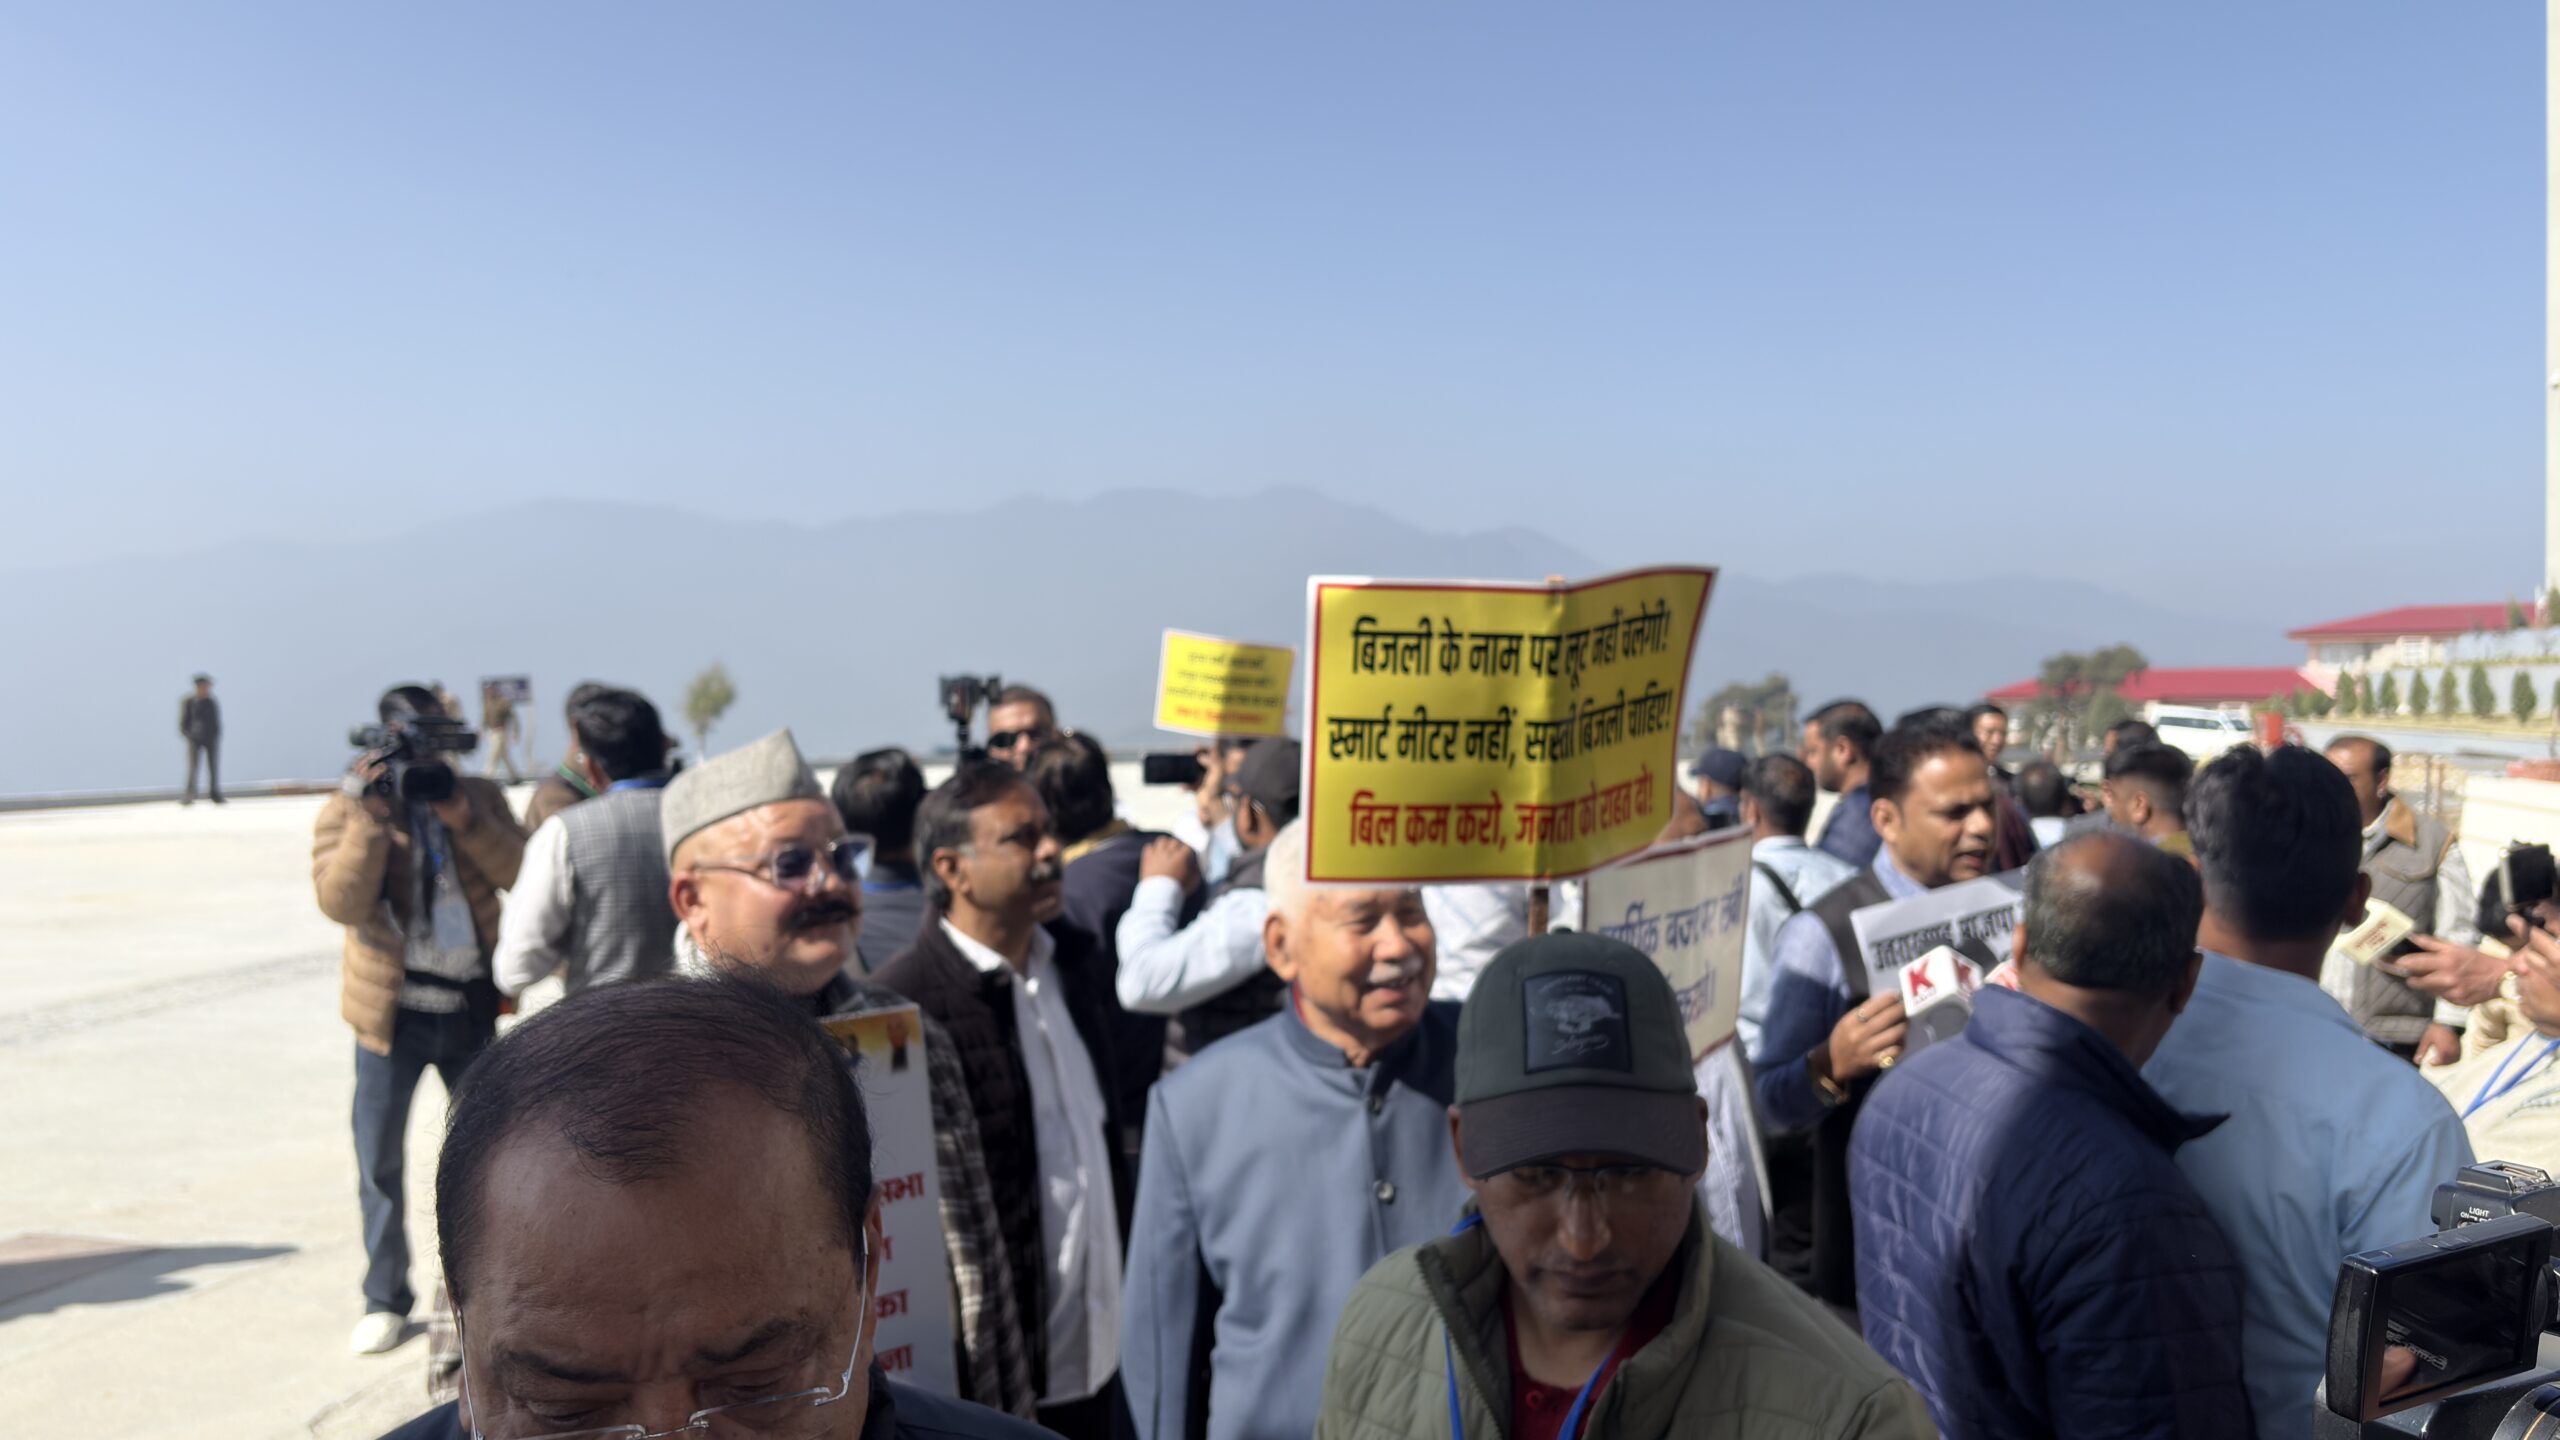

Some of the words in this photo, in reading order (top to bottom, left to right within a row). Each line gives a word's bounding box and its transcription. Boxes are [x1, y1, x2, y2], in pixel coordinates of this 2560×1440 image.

[1352, 615, 1433, 675] बिजली
[1438, 617, 1463, 676] के
[1468, 632, 1524, 676] नाम
[1529, 634, 1562, 678] पर
[1564, 629, 1590, 691] लूट
[1591, 604, 1623, 665] नहीं
[1622, 597, 1671, 658] चलेगी!
[1328, 703, 1392, 761] स्मार्ट
[1397, 705, 1460, 762] मीटर
[1465, 704, 1517, 769] नहीं,
[1524, 702, 1577, 763] सस्ती
[1578, 688, 1626, 755] बिजली
[1625, 681, 1673, 738] चाहिए!
[1350, 789, 1399, 847] बिल
[1405, 803, 1451, 847] कम
[1455, 789, 1507, 853] करो,
[1515, 800, 1576, 847] जनता
[1576, 778, 1598, 836] को
[1598, 780, 1633, 830] राहत
[1633, 762, 1654, 817] दो!
[2460, 1211, 2470, 1219] ON
[2469, 1206, 2490, 1218] LIGHT
